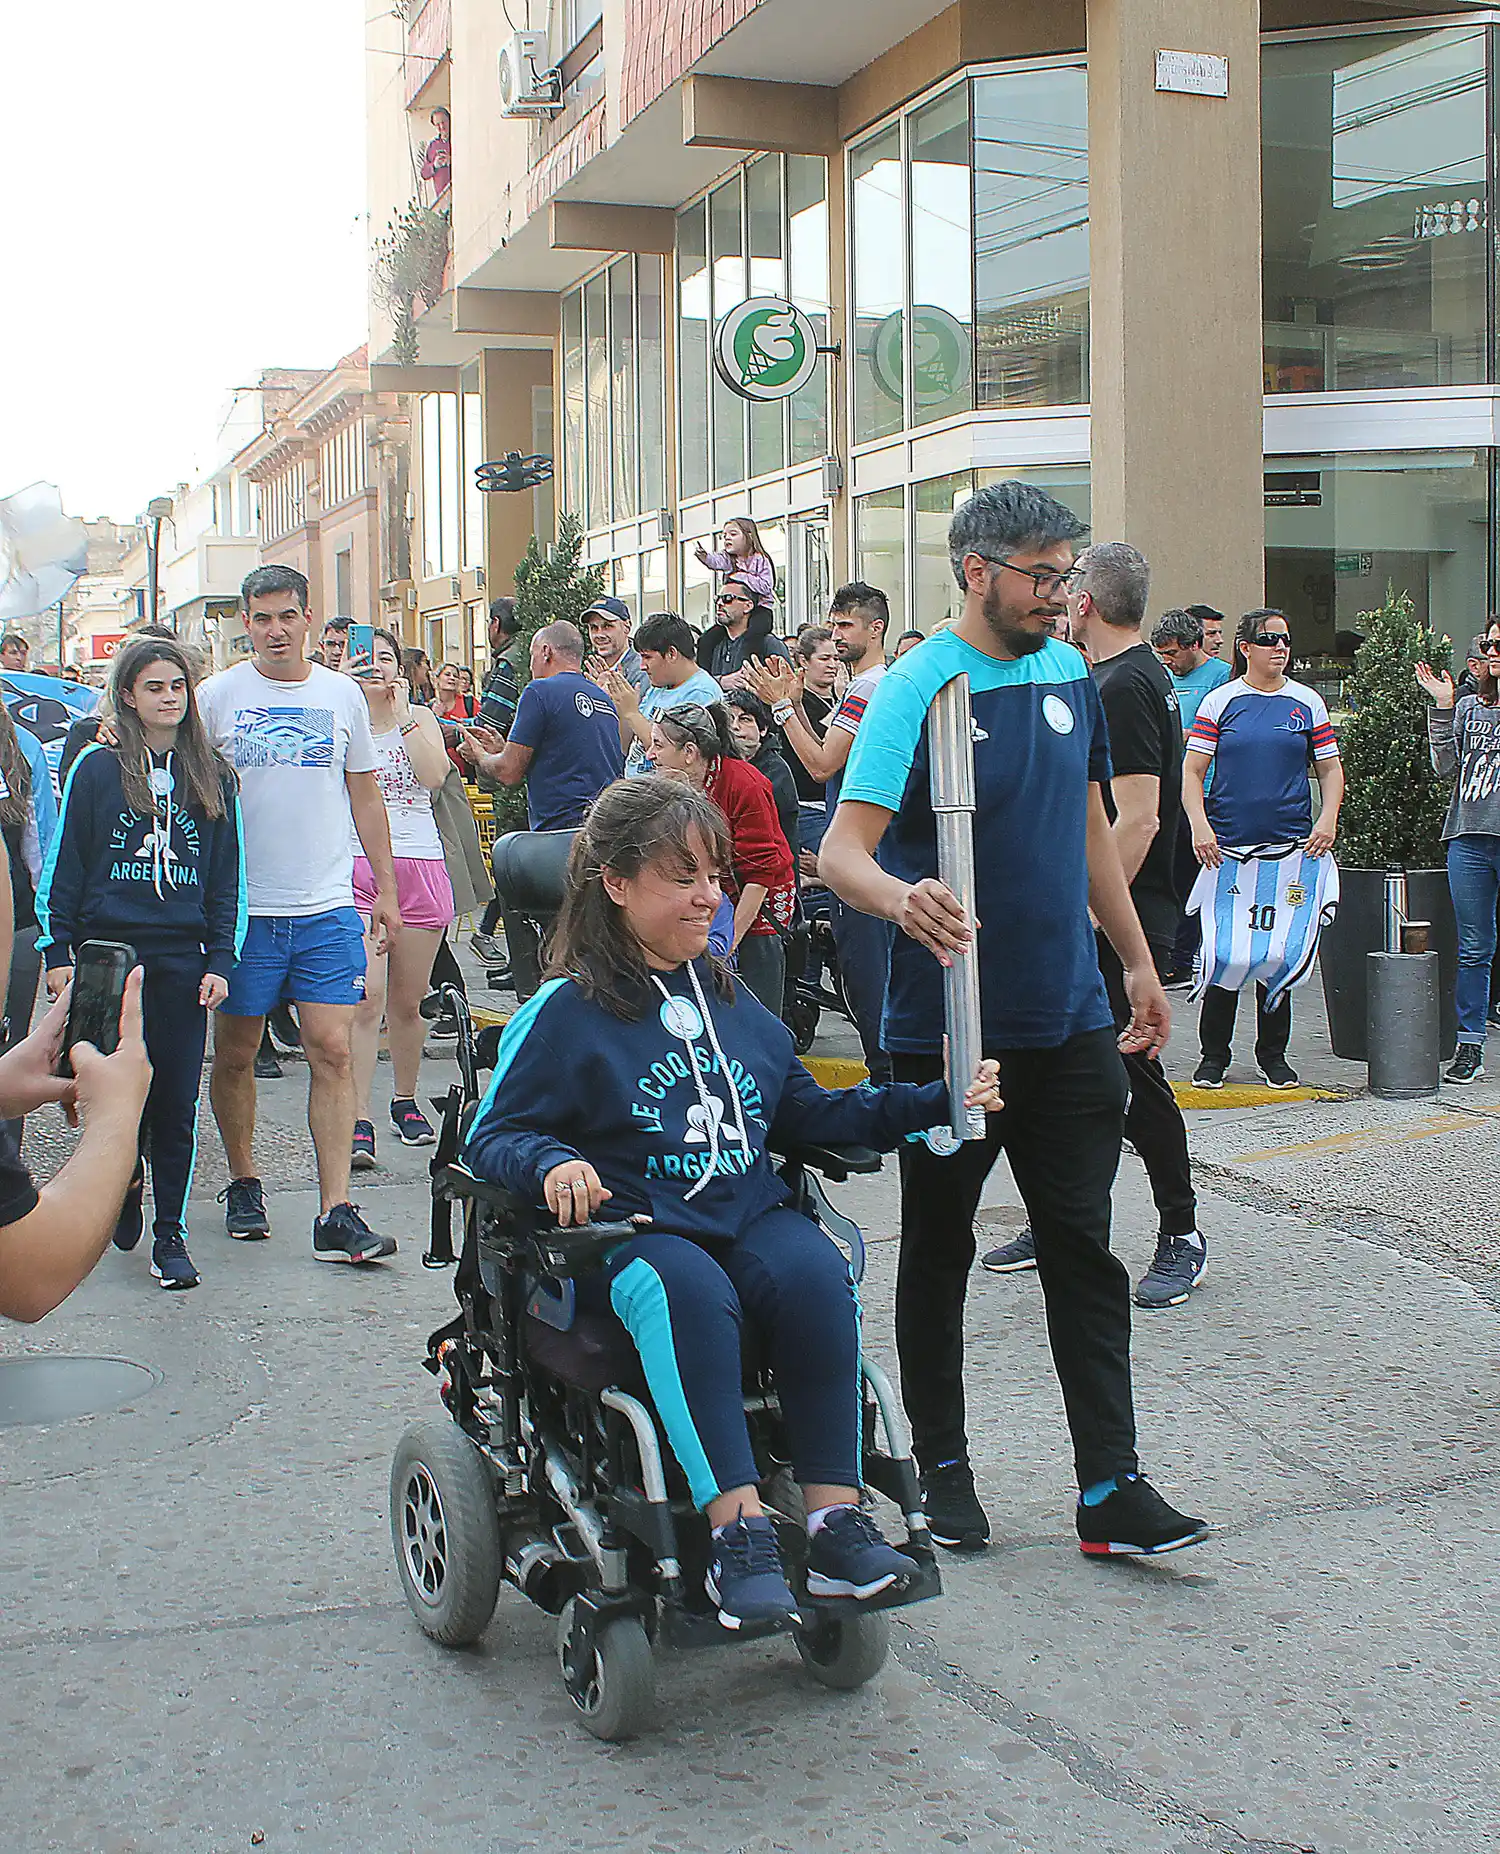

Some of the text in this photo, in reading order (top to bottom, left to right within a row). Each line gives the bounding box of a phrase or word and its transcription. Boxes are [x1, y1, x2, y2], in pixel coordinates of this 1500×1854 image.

[110, 828, 128, 849] LE
[110, 861, 199, 886] ARGENINA
[1248, 903, 1277, 931] 10
[637, 1051, 692, 1100] COQ
[631, 1102, 665, 1133] LE
